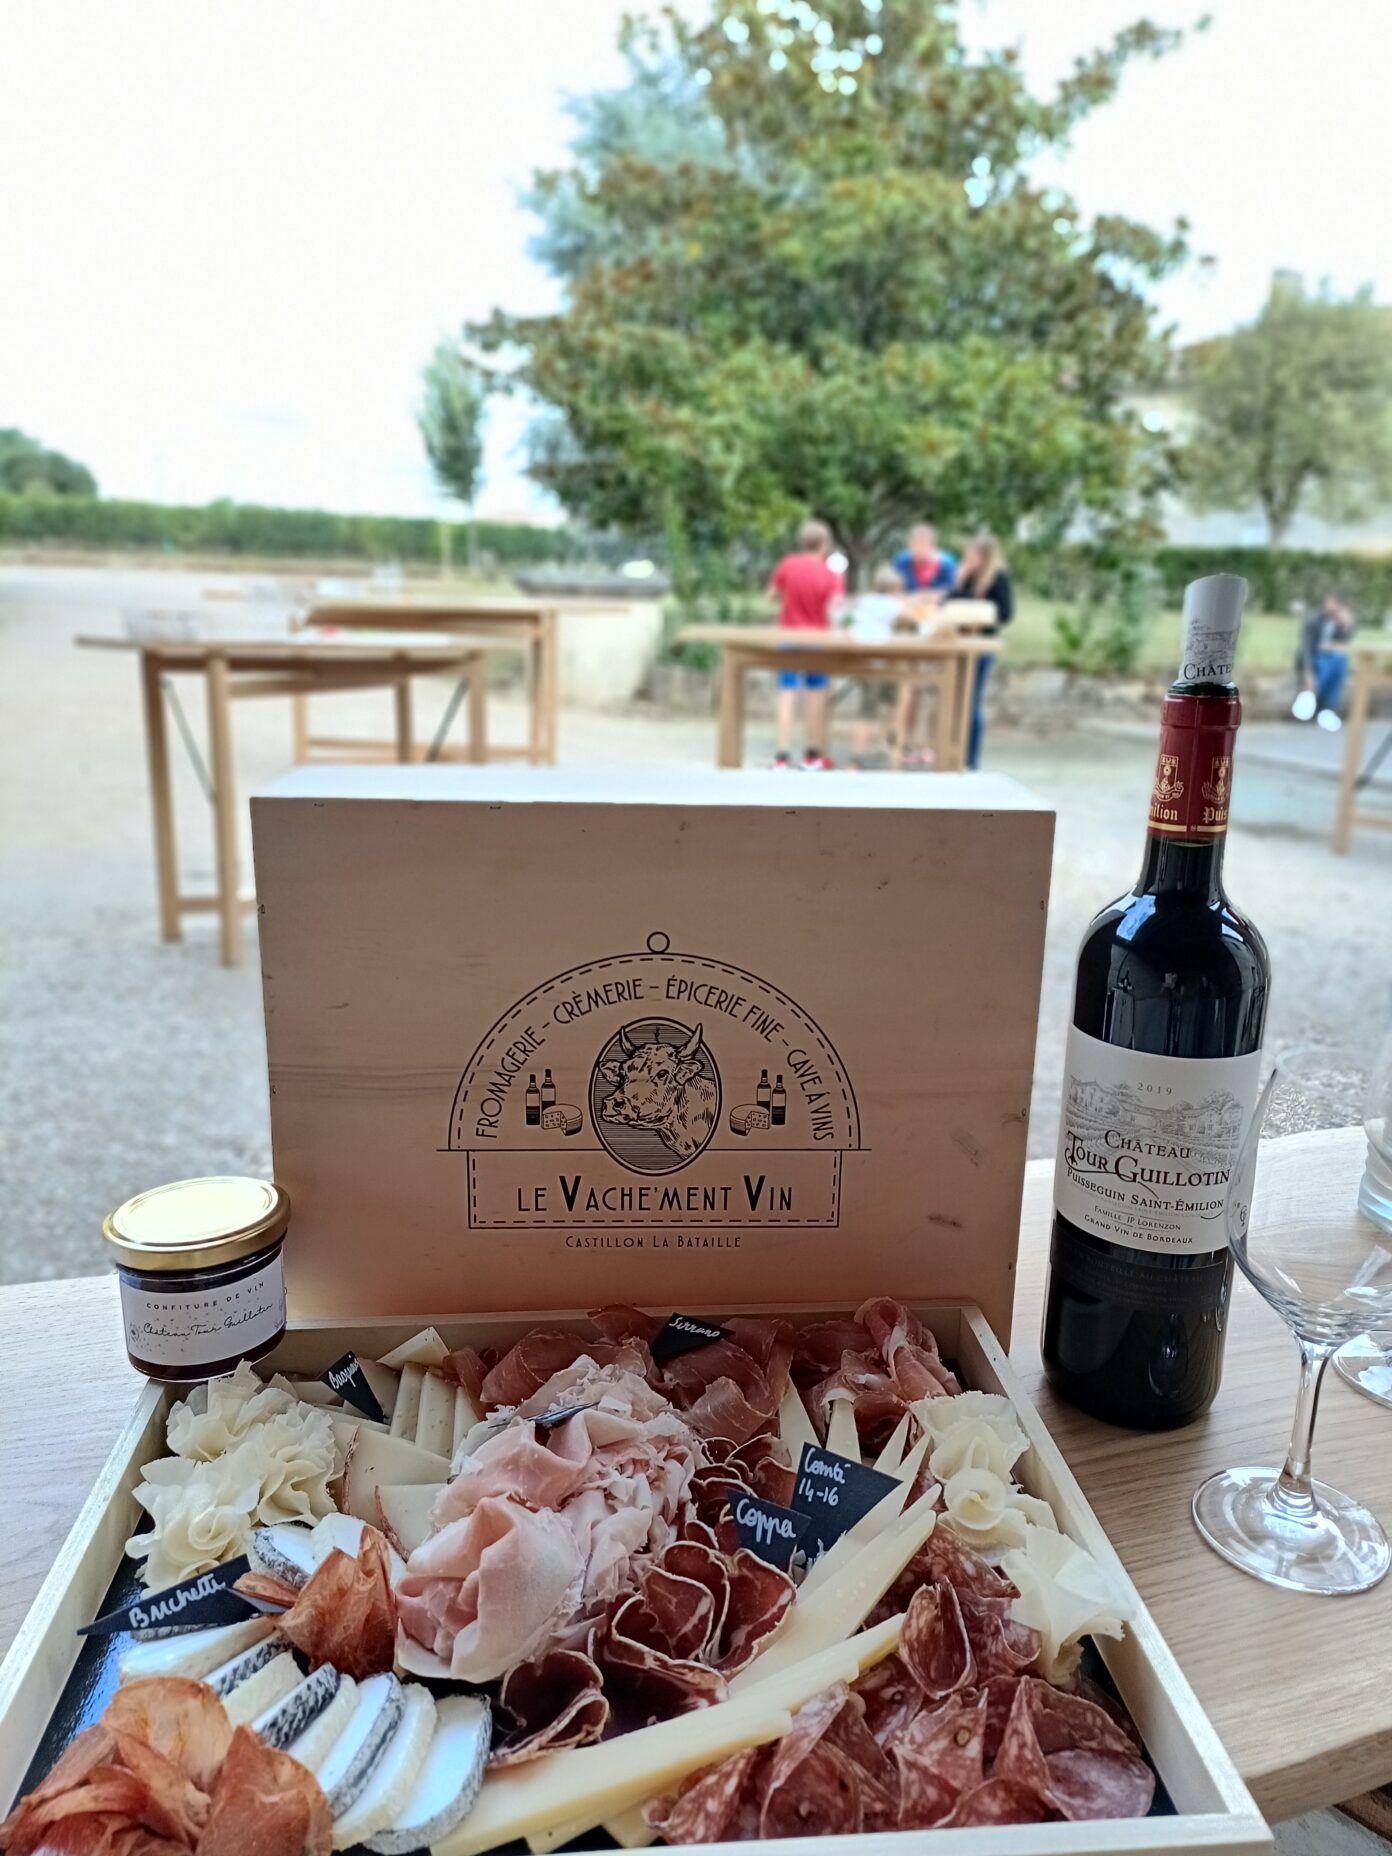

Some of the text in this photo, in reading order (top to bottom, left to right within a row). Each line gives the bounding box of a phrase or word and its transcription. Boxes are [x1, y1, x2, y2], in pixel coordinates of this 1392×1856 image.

[475, 1025, 547, 1138] FROMAGERIE
[553, 978, 645, 1024] CRÈMERIE
[665, 974, 747, 1018] ÉPICERIE
[742, 1004, 785, 1043] FINE
[787, 1048, 822, 1091] CAVE
[810, 1103, 835, 1141] VINS
[1137, 1081, 1173, 1096] 2019
[1065, 1130, 1231, 1187] TOUR GUILLOTIN
[1104, 1129, 1191, 1159] CHÂTEAU
[517, 1187, 548, 1212] LE
[743, 1175, 793, 1212] VIN
[1067, 1168, 1125, 1202] PUISSEGUIN
[1084, 1214, 1193, 1244] GRAND VIN DE BORDEAUX
[1094, 1205, 1121, 1221] FAMILLE
[1137, 1218, 1182, 1231] LORENZON
[565, 1235, 741, 1248] CASTILLON LA BATAILLE
[146, 1281, 264, 1311] CONFITURE DE VIN
[191, 1324, 221, 1335] Tour
[224, 1304, 273, 1329] Guillotin
[798, 1477, 839, 1507] 14-16
[736, 1498, 797, 1545] Coppa
